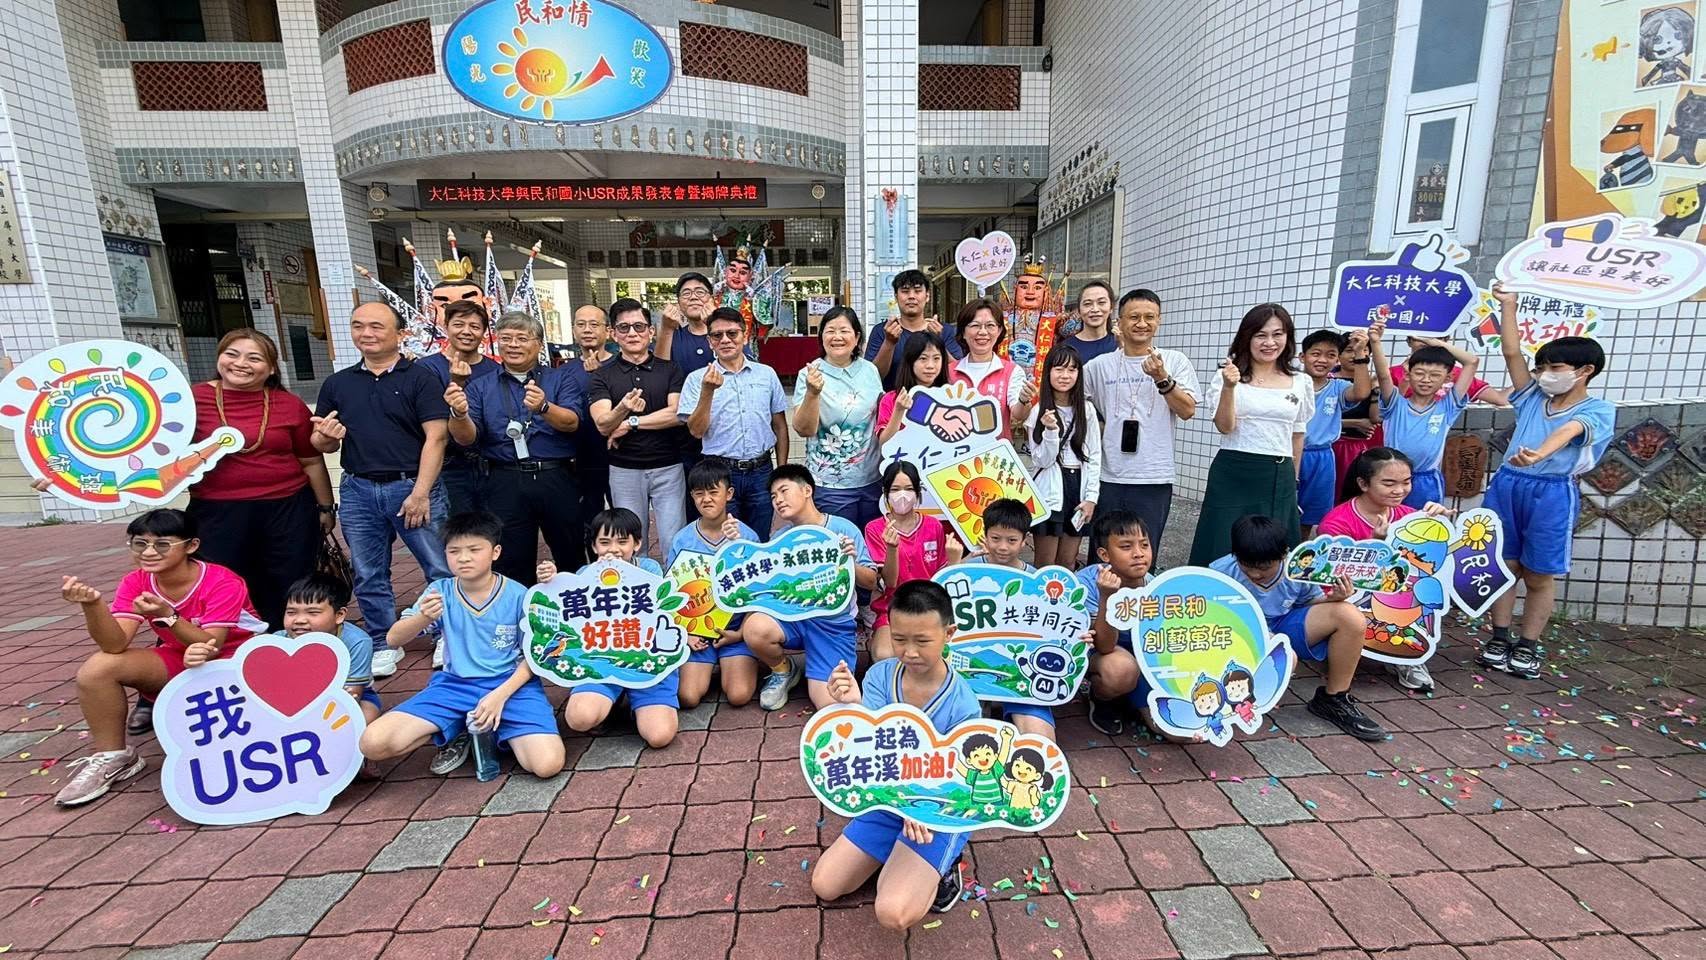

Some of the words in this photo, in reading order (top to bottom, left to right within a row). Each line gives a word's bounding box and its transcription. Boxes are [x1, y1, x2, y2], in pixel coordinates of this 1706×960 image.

[515, 0, 592, 27] 民和情
[461, 35, 486, 83] 陽光
[629, 39, 650, 88] 歡笑
[429, 185, 758, 201] 大仁科技大學與民和國小USR成果發表會暨揭牌典禮
[969, 258, 1007, 272] 一起更好
[1586, 246, 1661, 268] USR
[1346, 274, 1462, 297] 大仁科技大學
[1527, 260, 1671, 288] 讓社區更美好
[1499, 295, 1586, 318] 牌典禮
[997, 471, 1026, 494] 民和情
[1328, 547, 1378, 563] 智慧互動
[1333, 564, 1377, 577] 綠色未來
[559, 583, 654, 621] 萬年溪
[1115, 594, 1206, 621] 水岸民和
[952, 599, 997, 631] SR
[1002, 605, 1082, 638] 共學同行
[582, 617, 653, 650] 好讚!
[1143, 624, 1233, 654] 創藝萬年
[1038, 681, 1052, 692] AI
[185, 684, 252, 746] 我
[854, 726, 920, 751] 一起為
[189, 731, 330, 805] USR
[824, 752, 955, 790] 萬年溪加油!
